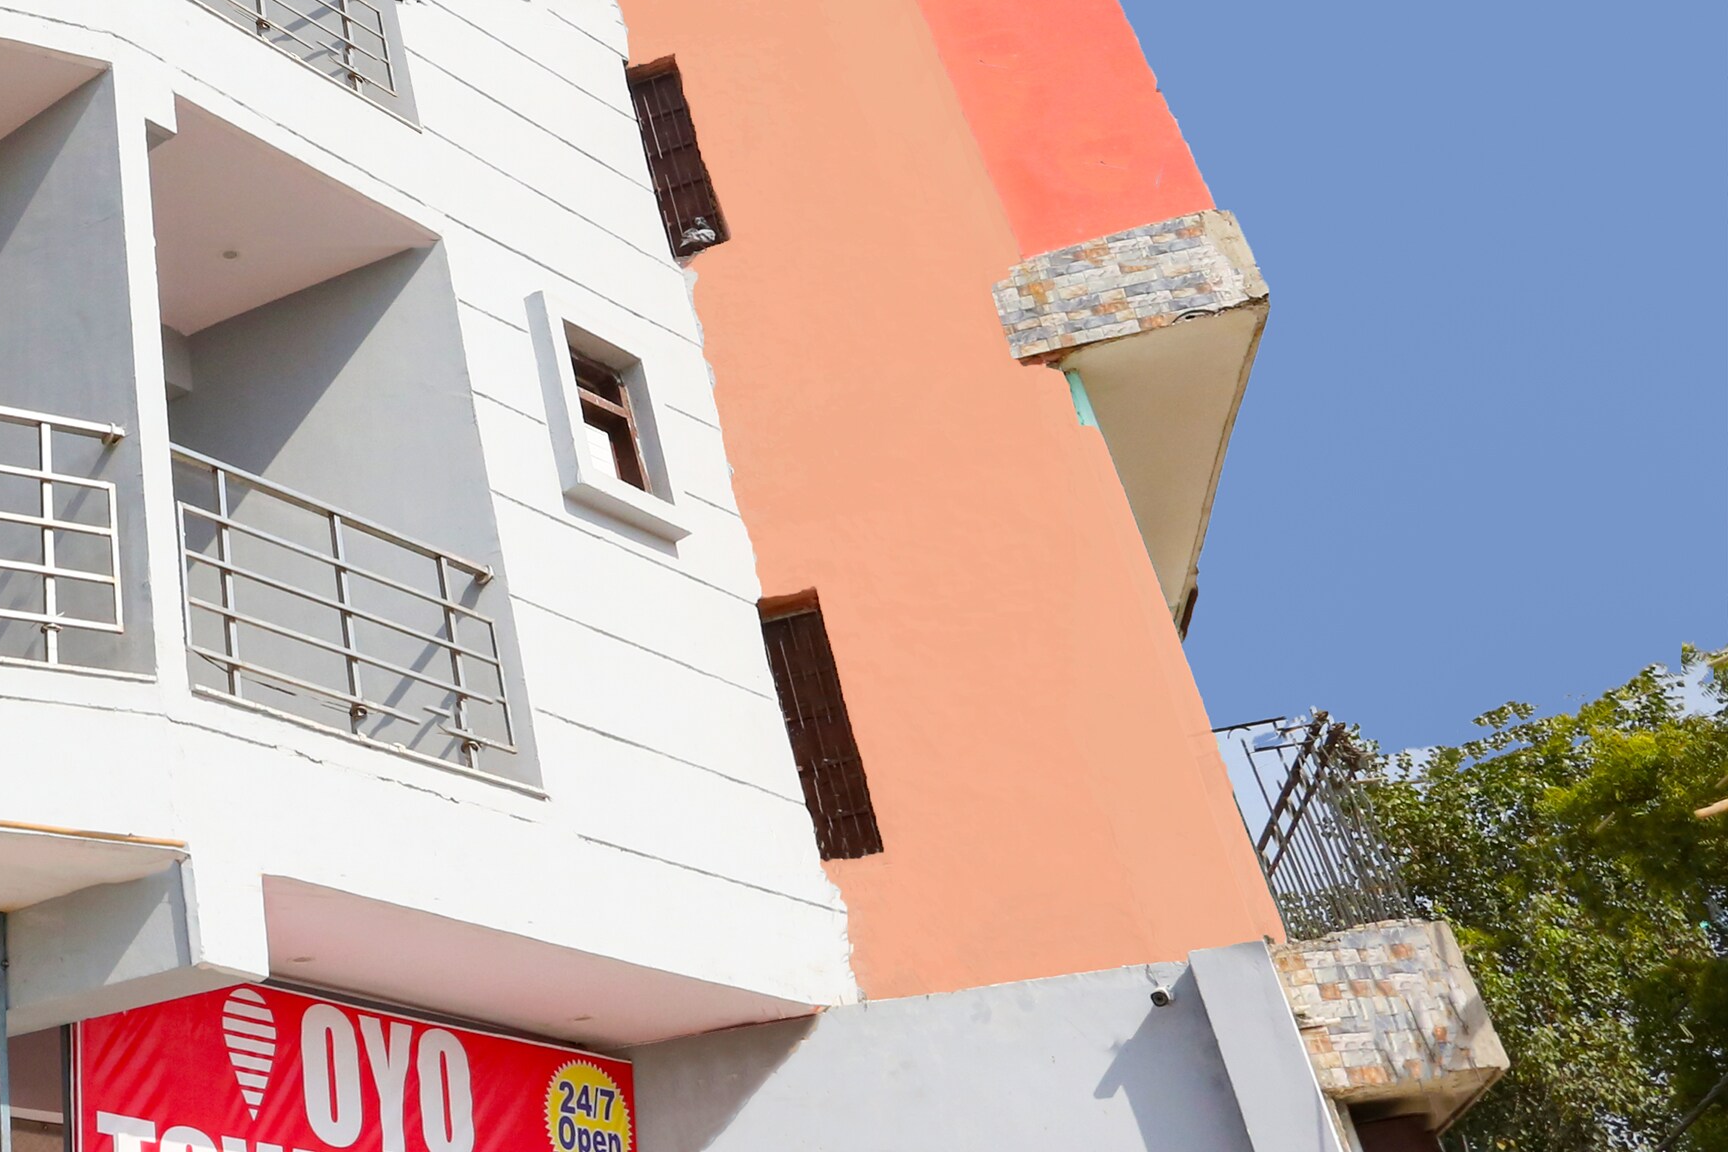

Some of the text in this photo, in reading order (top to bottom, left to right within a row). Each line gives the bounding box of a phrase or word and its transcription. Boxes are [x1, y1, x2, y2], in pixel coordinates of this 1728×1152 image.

[301, 1003, 476, 1152] OYO
[559, 1080, 615, 1121] 24/7
[558, 1115, 622, 1152] Open
